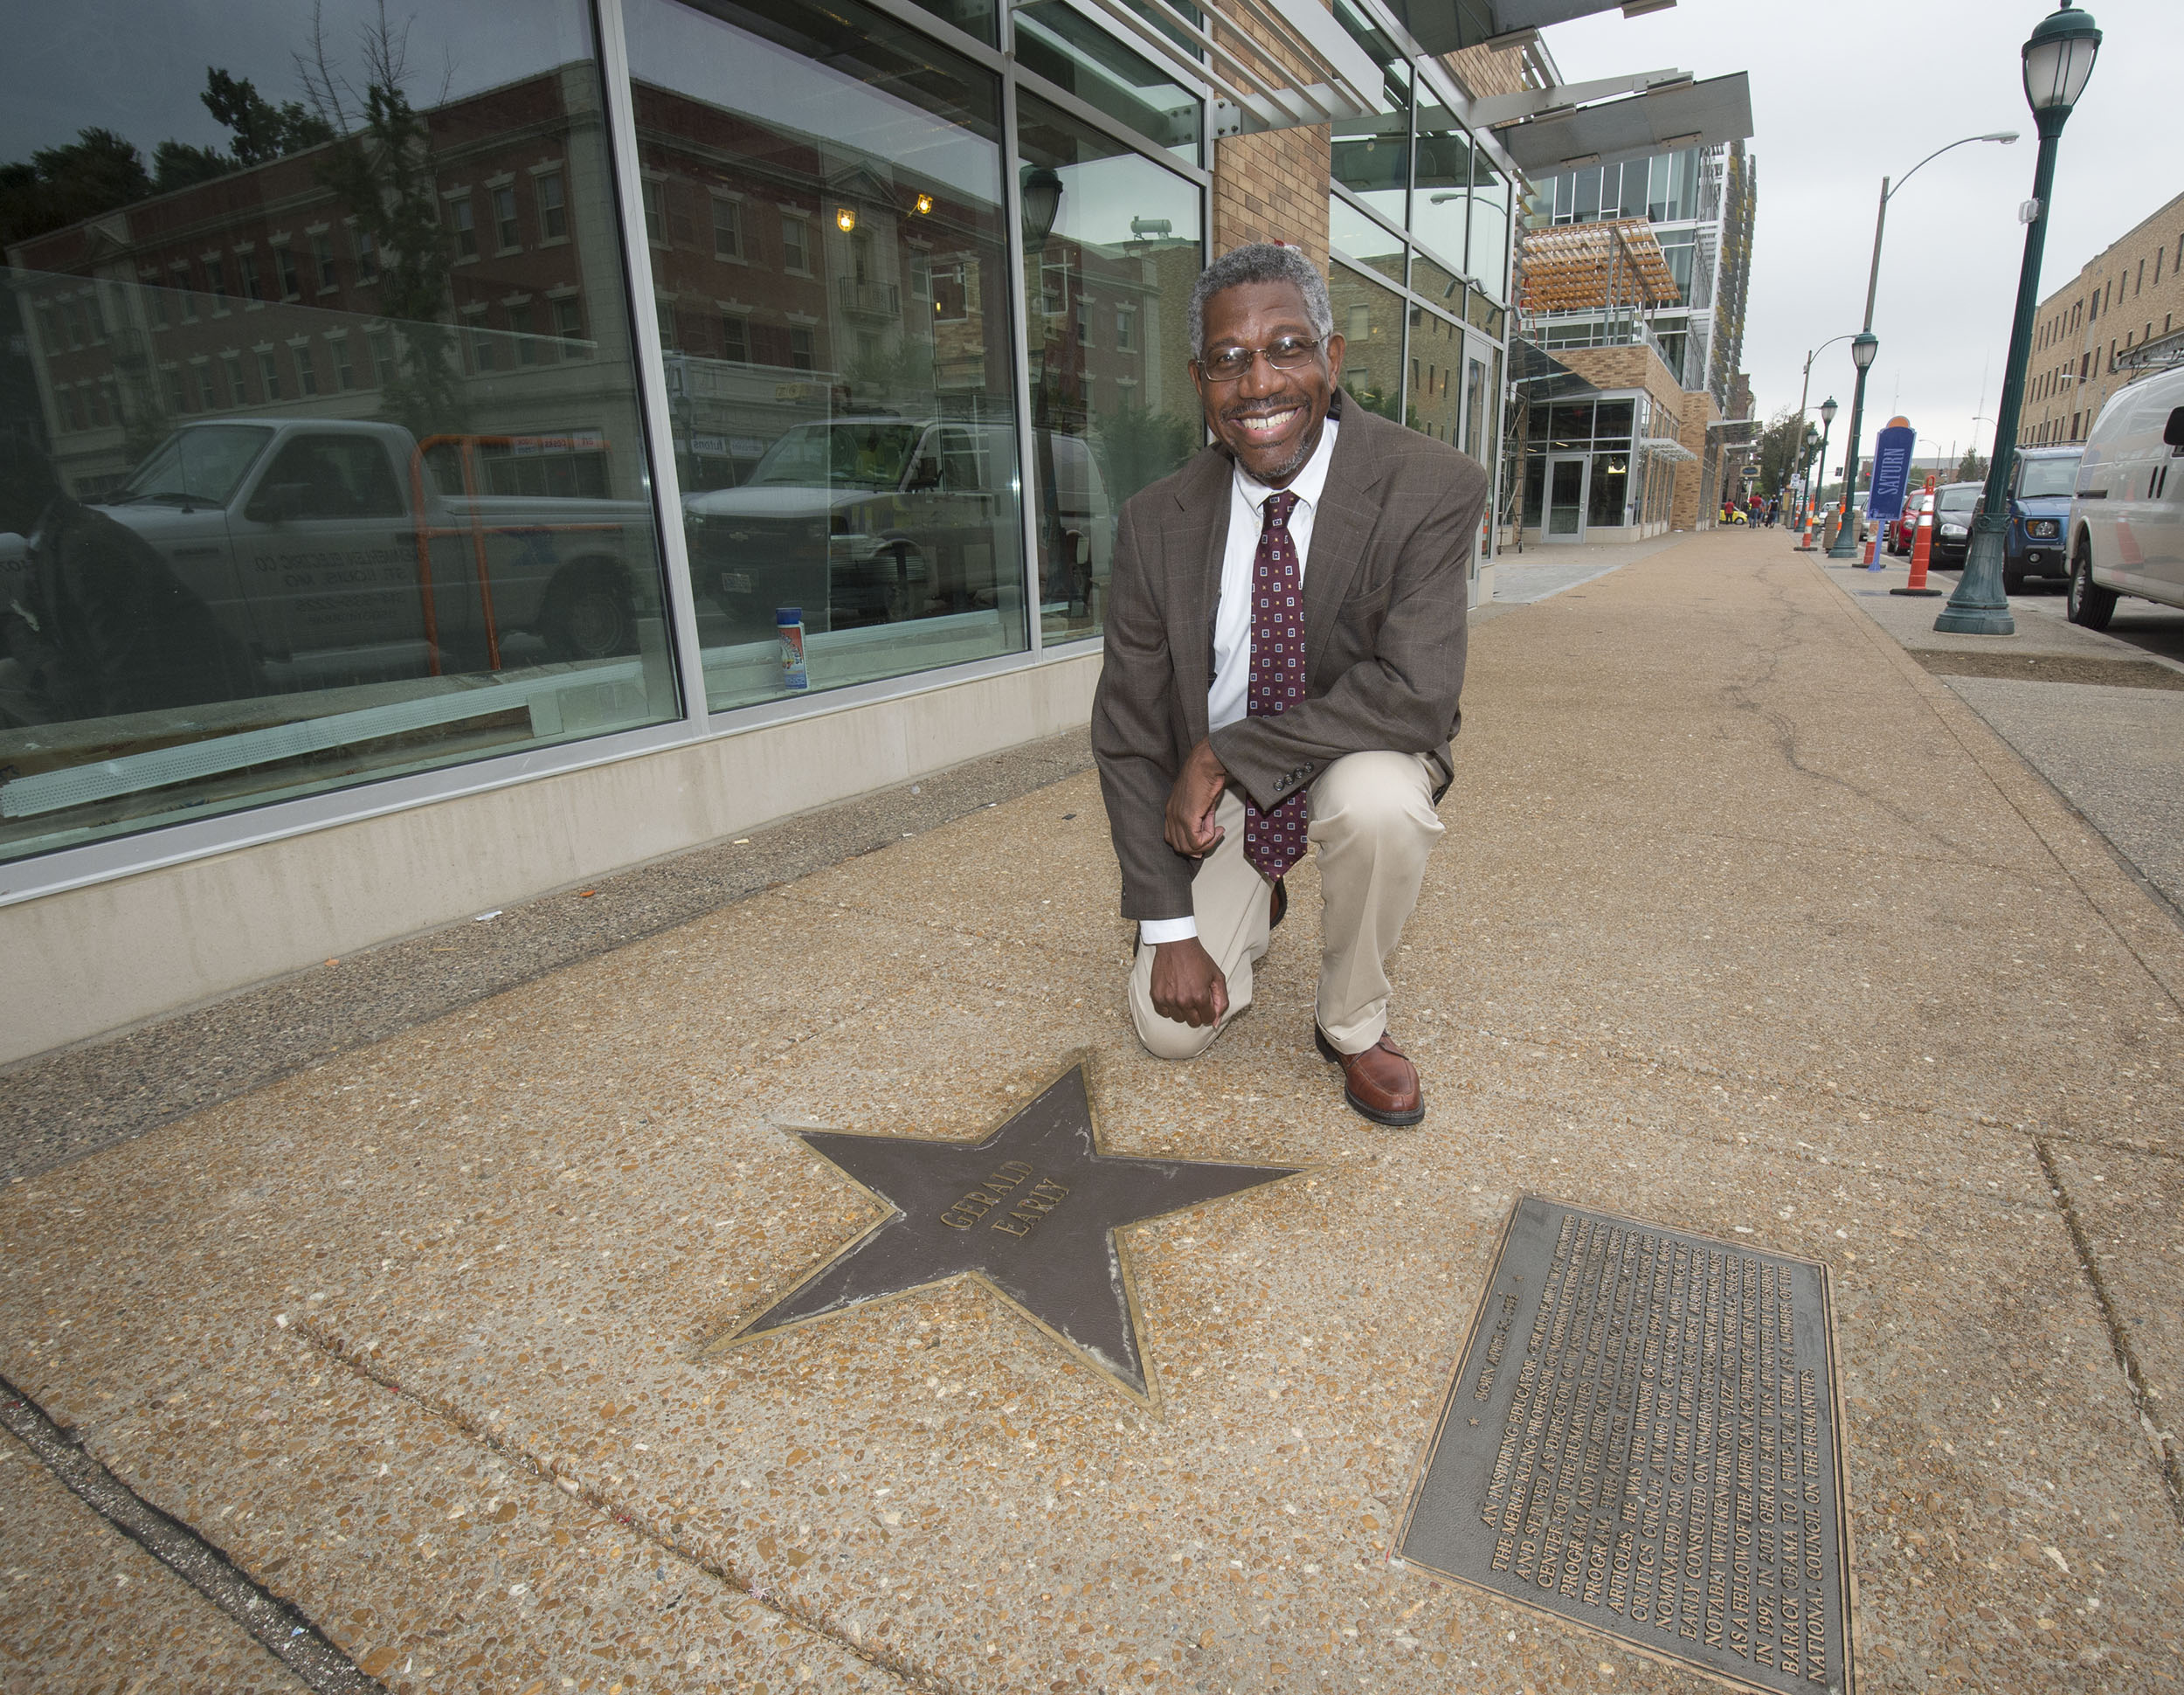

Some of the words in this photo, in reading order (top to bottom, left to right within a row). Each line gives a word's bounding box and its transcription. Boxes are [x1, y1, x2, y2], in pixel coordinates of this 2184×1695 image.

[1877, 447, 1905, 495] SATURN
[940, 1160, 1033, 1230] GERALD
[991, 1178, 1070, 1238] EARLY
[1554, 1213, 1575, 1260] APPOINTED
[1573, 1217, 1592, 1253] ENGLISH
[1642, 1231, 1655, 1253] AND
[1659, 1235, 1672, 1263] BOOK
[1676, 1240, 1688, 1261] WAS
[1548, 1259, 1563, 1281] WAS
[1571, 1253, 1583, 1265] IN
[1637, 1253, 1651, 1286] BOOKS
[1710, 1248, 1722, 1275] MOST
[1780, 1263, 1790, 1285] THE
[1539, 1280, 1557, 1311] EARLY
[1560, 1264, 1579, 1306] LETTERS
[1614, 1263, 1632, 1314] AMERICAN
[1651, 1262, 1669, 1312] NATIONAL
[1671, 1261, 1685, 1296] TWICE
[1688, 1277, 1702, 1314] ALBUM
[1744, 1256, 1756, 1299] SCIENCES
[1761, 1259, 1773, 1311] PRESIDENT
[1780, 1284, 1791, 1300] OF
[1632, 1284, 1647, 1318] MANY
[1668, 1296, 1682, 1322] AND
[1743, 1297, 1754, 1321] AND
[1761, 1310, 1773, 1327] BY
[1527, 1311, 1549, 1356] GERALD
[1549, 1304, 1570, 1352] MODERN
[1565, 1284, 1593, 1361] WASHINGTON
[1586, 1299, 1607, 1354] AMERICAN
[1605, 1312, 1624, 1361] AFRICAN
[1629, 1318, 1641, 1334] OF
[1648, 1311, 1662, 1337] 1994
[1685, 1313, 1698, 1344] BEST
[1742, 1319, 1754, 1348] ARTS
[1780, 1300, 1792, 1345] MEMBER
[1545, 1350, 1559, 1367] OF
[1621, 1334, 1639, 1380] EDITOR
[1644, 1336, 1659, 1360] THE
[1660, 1322, 1678, 1388] CRITICISM
[1683, 1342, 1696, 1368] FOR
[1700, 1304, 1717, 1386] DOCUMENTARY
[1741, 1346, 1753, 1363] OF
[1760, 1326, 1773, 1391] APPOINTED
[1780, 1343, 1792, 1354] A
[1780, 1354, 1792, 1372] AS
[1474, 1366, 1496, 1402] BORN
[1485, 1332, 1506, 1366] APRIL
[1561, 1360, 1576, 1379] OF
[1581, 1353, 1597, 1379] THE
[1600, 1359, 1615, 1387] AND
[1641, 1360, 1655, 1379] OF
[1720, 1351, 1734, 1379] AND
[1527, 1367, 1554, 1437] PROFESSOR
[1616, 1380, 1632, 1412] AND
[1634, 1379, 1653, 1433] WINNER
[1655, 1390, 1671, 1420] FOR
[1677, 1367, 1694, 1421] AWARDS
[1739, 1360, 1753, 1419] ACADEMY
[1759, 1390, 1773, 1420] WAS
[1780, 1372, 1793, 1408] TERM
[1545, 1379, 1572, 1450] DIRECTOR
[1588, 1386, 1611, 1445] AFRICAN
[1695, 1385, 1712, 1459] NUMEROUS
[1717, 1417, 1731, 1440] ON
[1606, 1413, 1627, 1475] AUTHOR
[1629, 1433, 1646, 1464] THE
[1649, 1419, 1668, 1474] AWARD
[1670, 1421, 1689, 1485] GRAMMY
[1736, 1418, 1752, 1492] AMERICAN
[1759, 1418, 1773, 1463] EARLY
[1487, 1425, 1518, 1500] INSPIRING
[1515, 1436, 1538, 1483] KLING
[1539, 1451, 1556, 1473] AS
[1558, 1456, 1576, 1491] THE
[1583, 1444, 1600, 1474] THE
[1692, 1458, 1708, 1484] ON
[1714, 1437, 1730, 1489] BURNS
[1803, 1447, 1818, 1478] THE
[1576, 1474, 1595, 1511] AND
[1600, 1475, 1617, 1510] THE
[1624, 1463, 1642, 1497] WAS
[1758, 1463, 1773, 1525] GERALD
[1781, 1484, 1794, 1498] A
[1804, 1479, 1819, 1505] ON
[1480, 1500, 1498, 1528] AN
[1502, 1482, 1526, 1536] MERLE
[1524, 1473, 1551, 1538] SERVED
[1551, 1491, 1569, 1523] FOR
[1620, 1498, 1637, 1526] HE
[1641, 1476, 1662, 1539] CIRCLE
[1667, 1486, 1683, 1519] FOR
[1712, 1485, 1728, 1520] KEN
[1735, 1490, 1750, 1524] THE
[1781, 1498, 1795, 1525] TO
[1685, 1484, 1706, 1580] CONSULTED
[1709, 1517, 1726, 1567] WITH
[1734, 1522, 1749, 1546] OF
[1757, 1526, 1773, 1564] 2013
[1805, 1505, 1822, 1581] COUNCIL
[1492, 1535, 1513, 1573] THE
[1514, 1539, 1536, 1581] AND
[1537, 1522, 1563, 1589] CENTER
[1559, 1509, 1589, 1599] PROGRAM,
[1781, 1526, 1797, 1591] OBAMA
[1630, 1540, 1655, 1624] CRITICS
[1655, 1519, 1680, 1632] NOMINATED
[1731, 1543, 1748, 1615] FELLOW
[1757, 1564, 1773, 1589] IN
[1680, 1579, 1699, 1642] EARLY
[1704, 1565, 1724, 1650] NOTABLY
[1731, 1612, 1746, 1629] A
[1730, 1628, 1746, 1658] AS
[1782, 1593, 1799, 1677] BARACK
[1807, 1581, 1827, 1686] NATIONAL
[1756, 1638, 1773, 1668] IN
